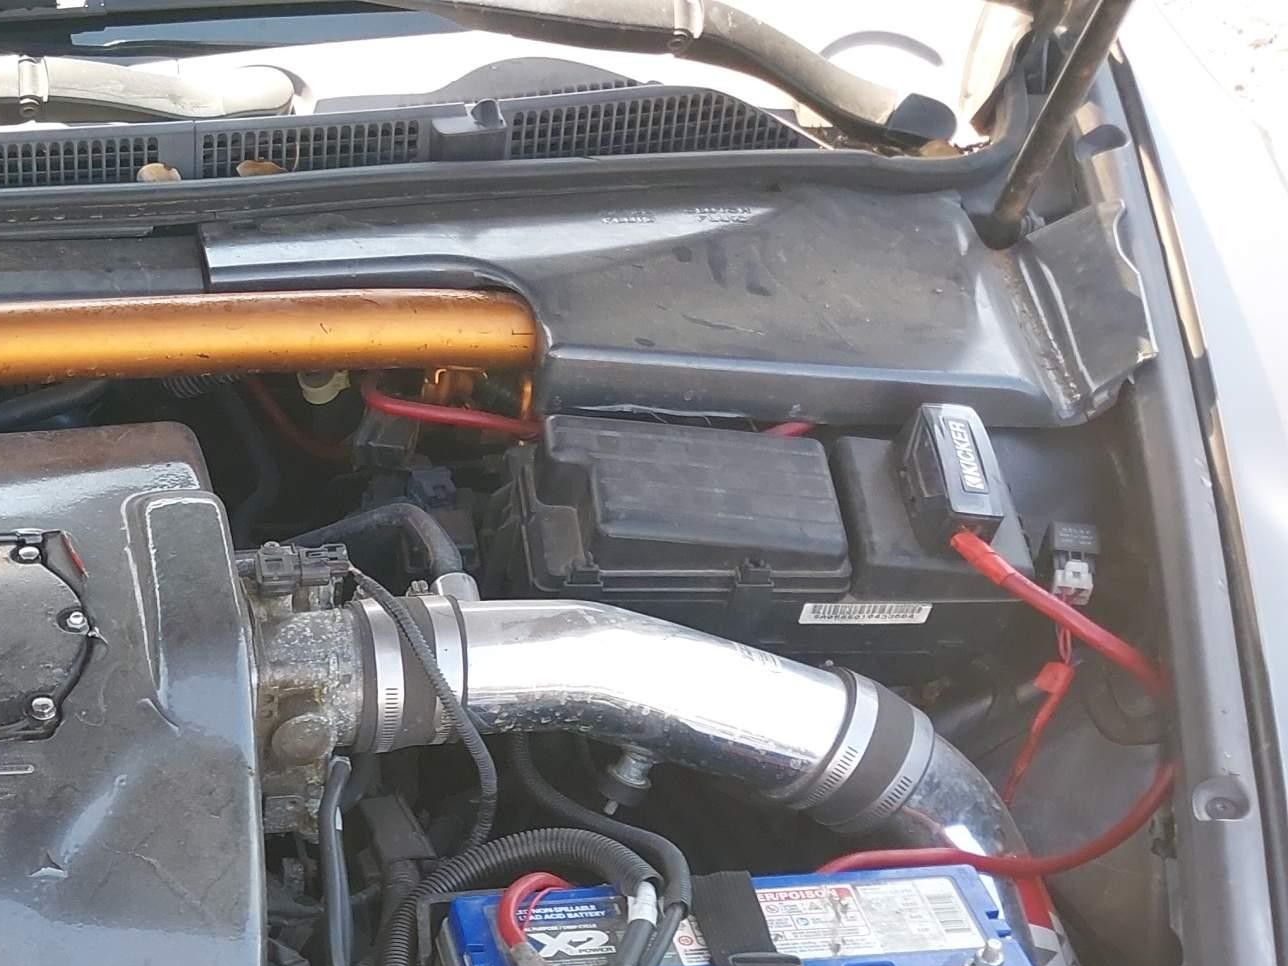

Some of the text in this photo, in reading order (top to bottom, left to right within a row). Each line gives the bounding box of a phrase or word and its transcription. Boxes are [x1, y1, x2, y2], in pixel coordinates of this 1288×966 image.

[948, 420, 982, 480] KICKER
[531, 904, 597, 915] NON-SPILLABLE
[544, 912, 567, 921] ACID
[567, 910, 607, 920] BATTERY
[525, 930, 610, 958] X2
[578, 946, 615, 954] POWER
